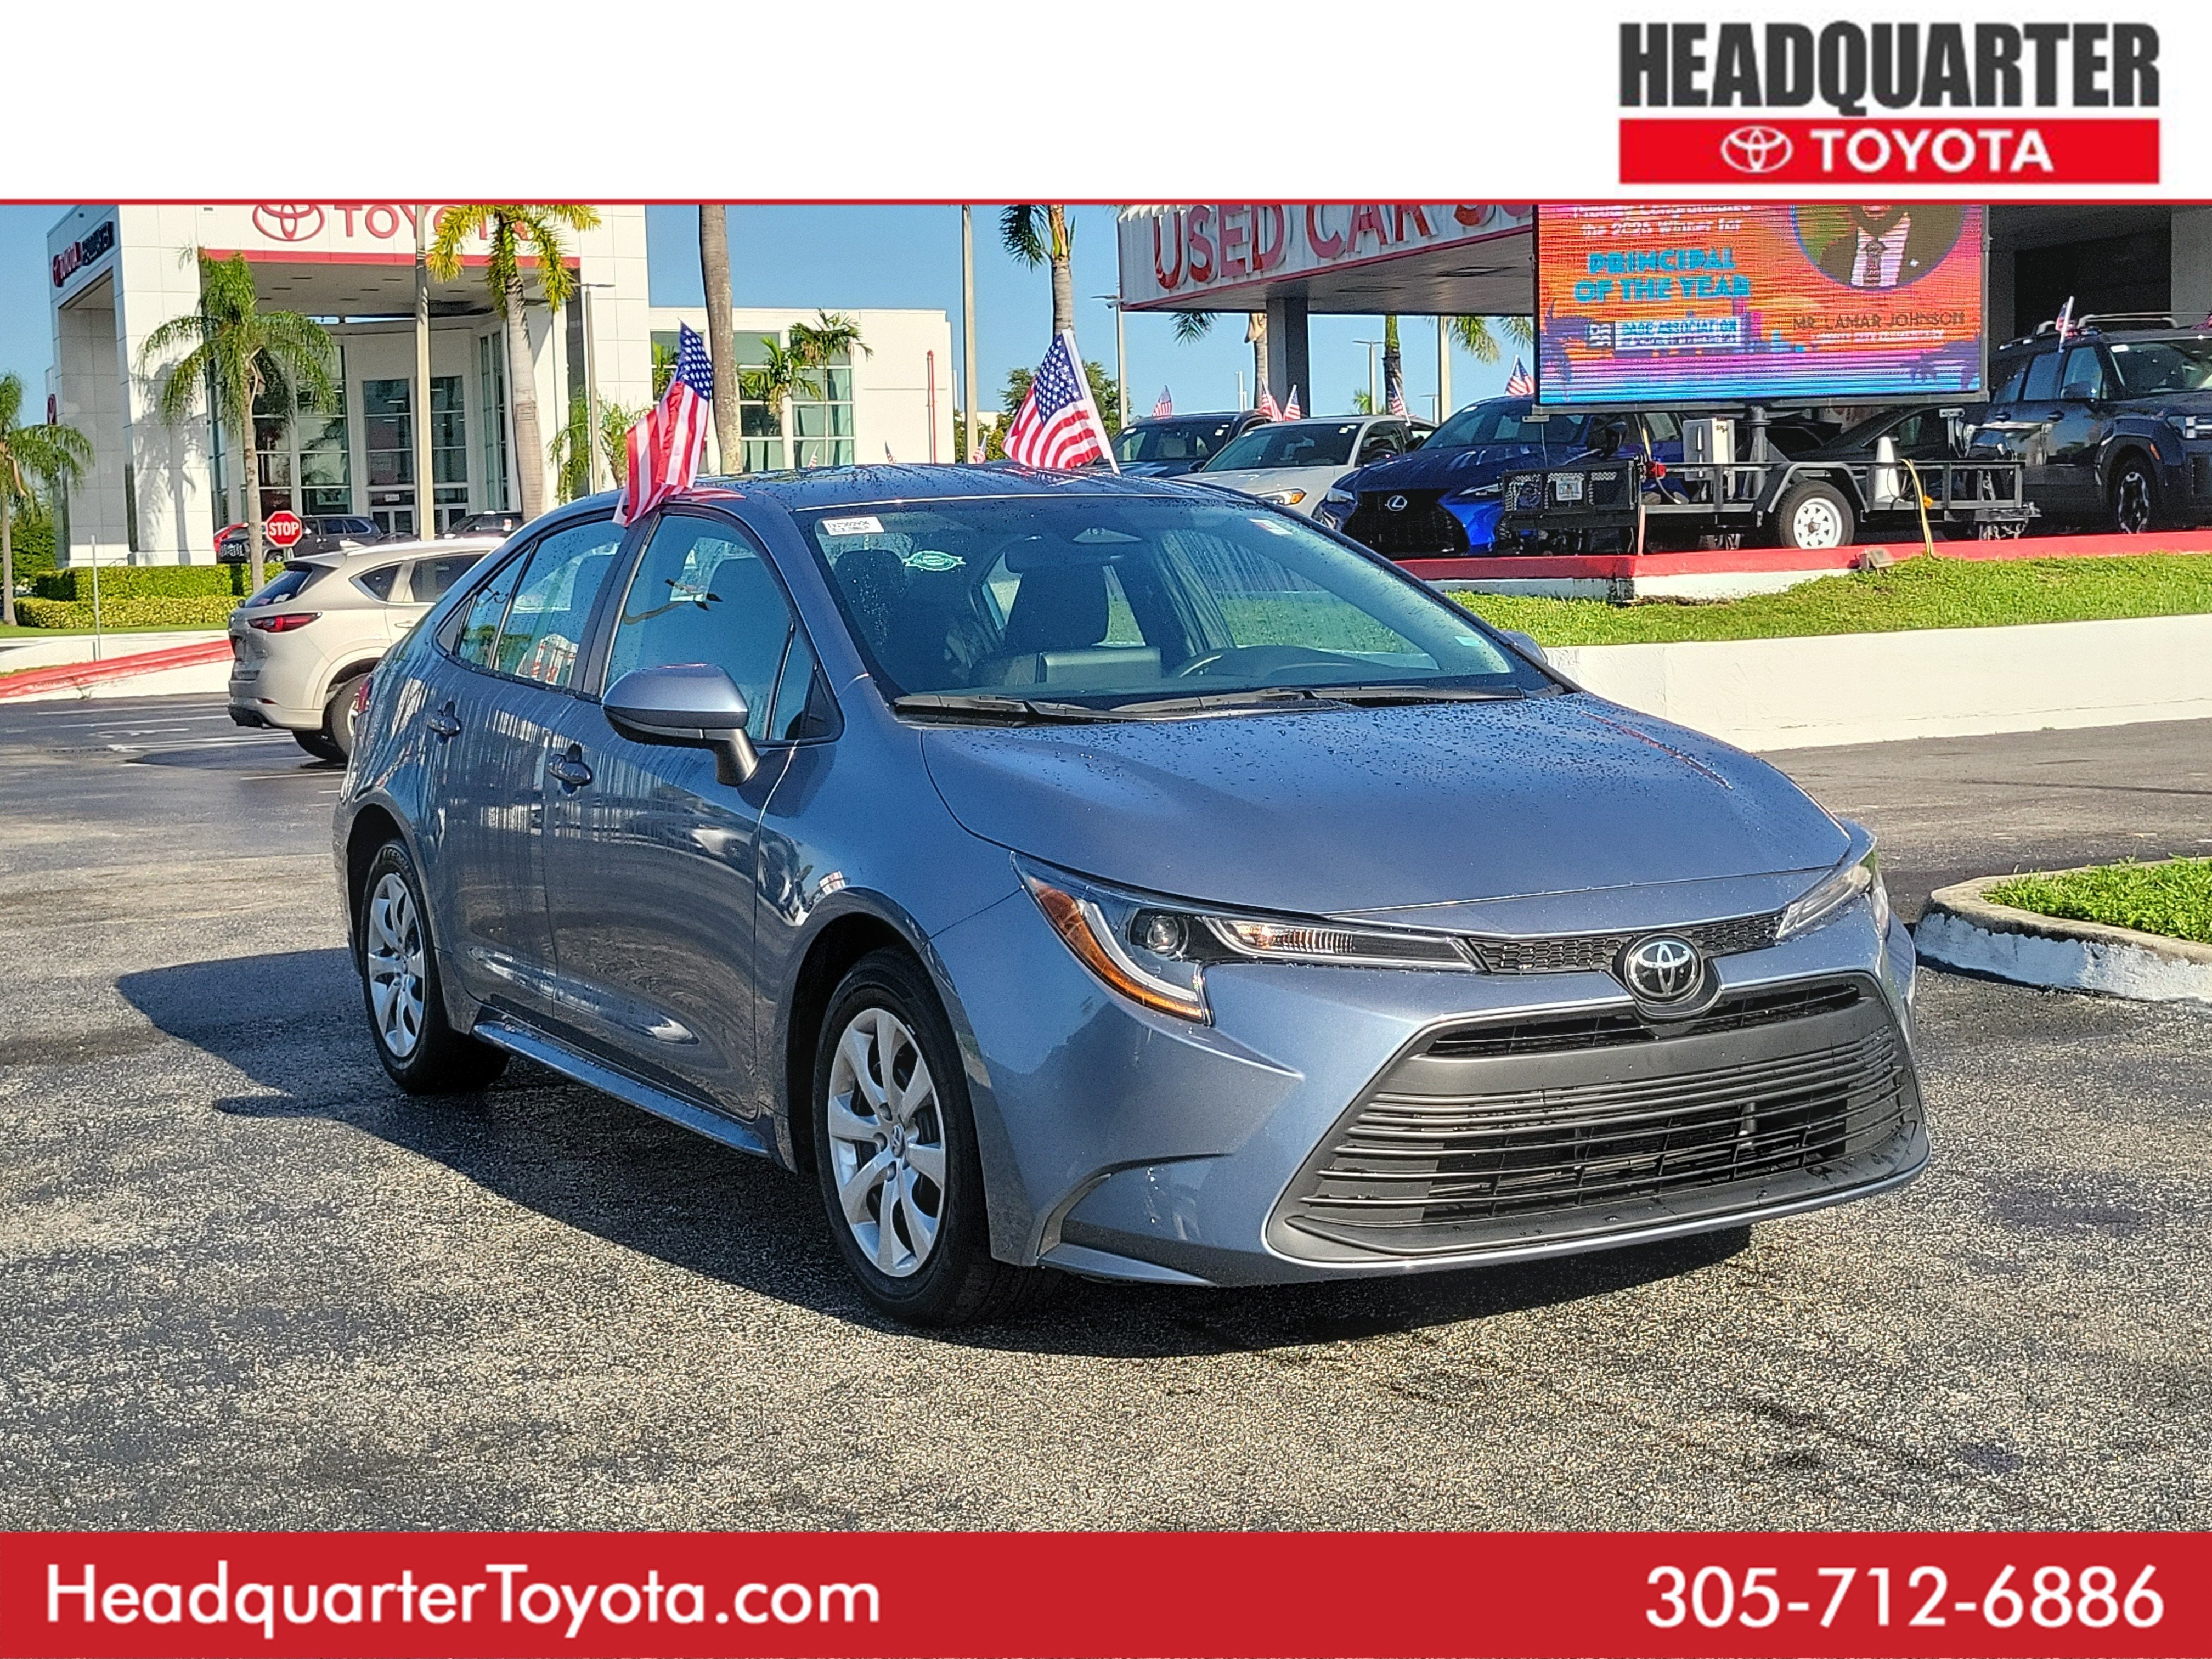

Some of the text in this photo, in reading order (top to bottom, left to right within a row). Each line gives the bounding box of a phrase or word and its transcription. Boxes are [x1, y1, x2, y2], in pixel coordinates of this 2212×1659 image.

[1153, 204, 1285, 290] USED
[1588, 246, 1736, 274] PRINCIPAL
[1573, 274, 1751, 303] OF THE YEAR
[269, 521, 300, 536] STOP
